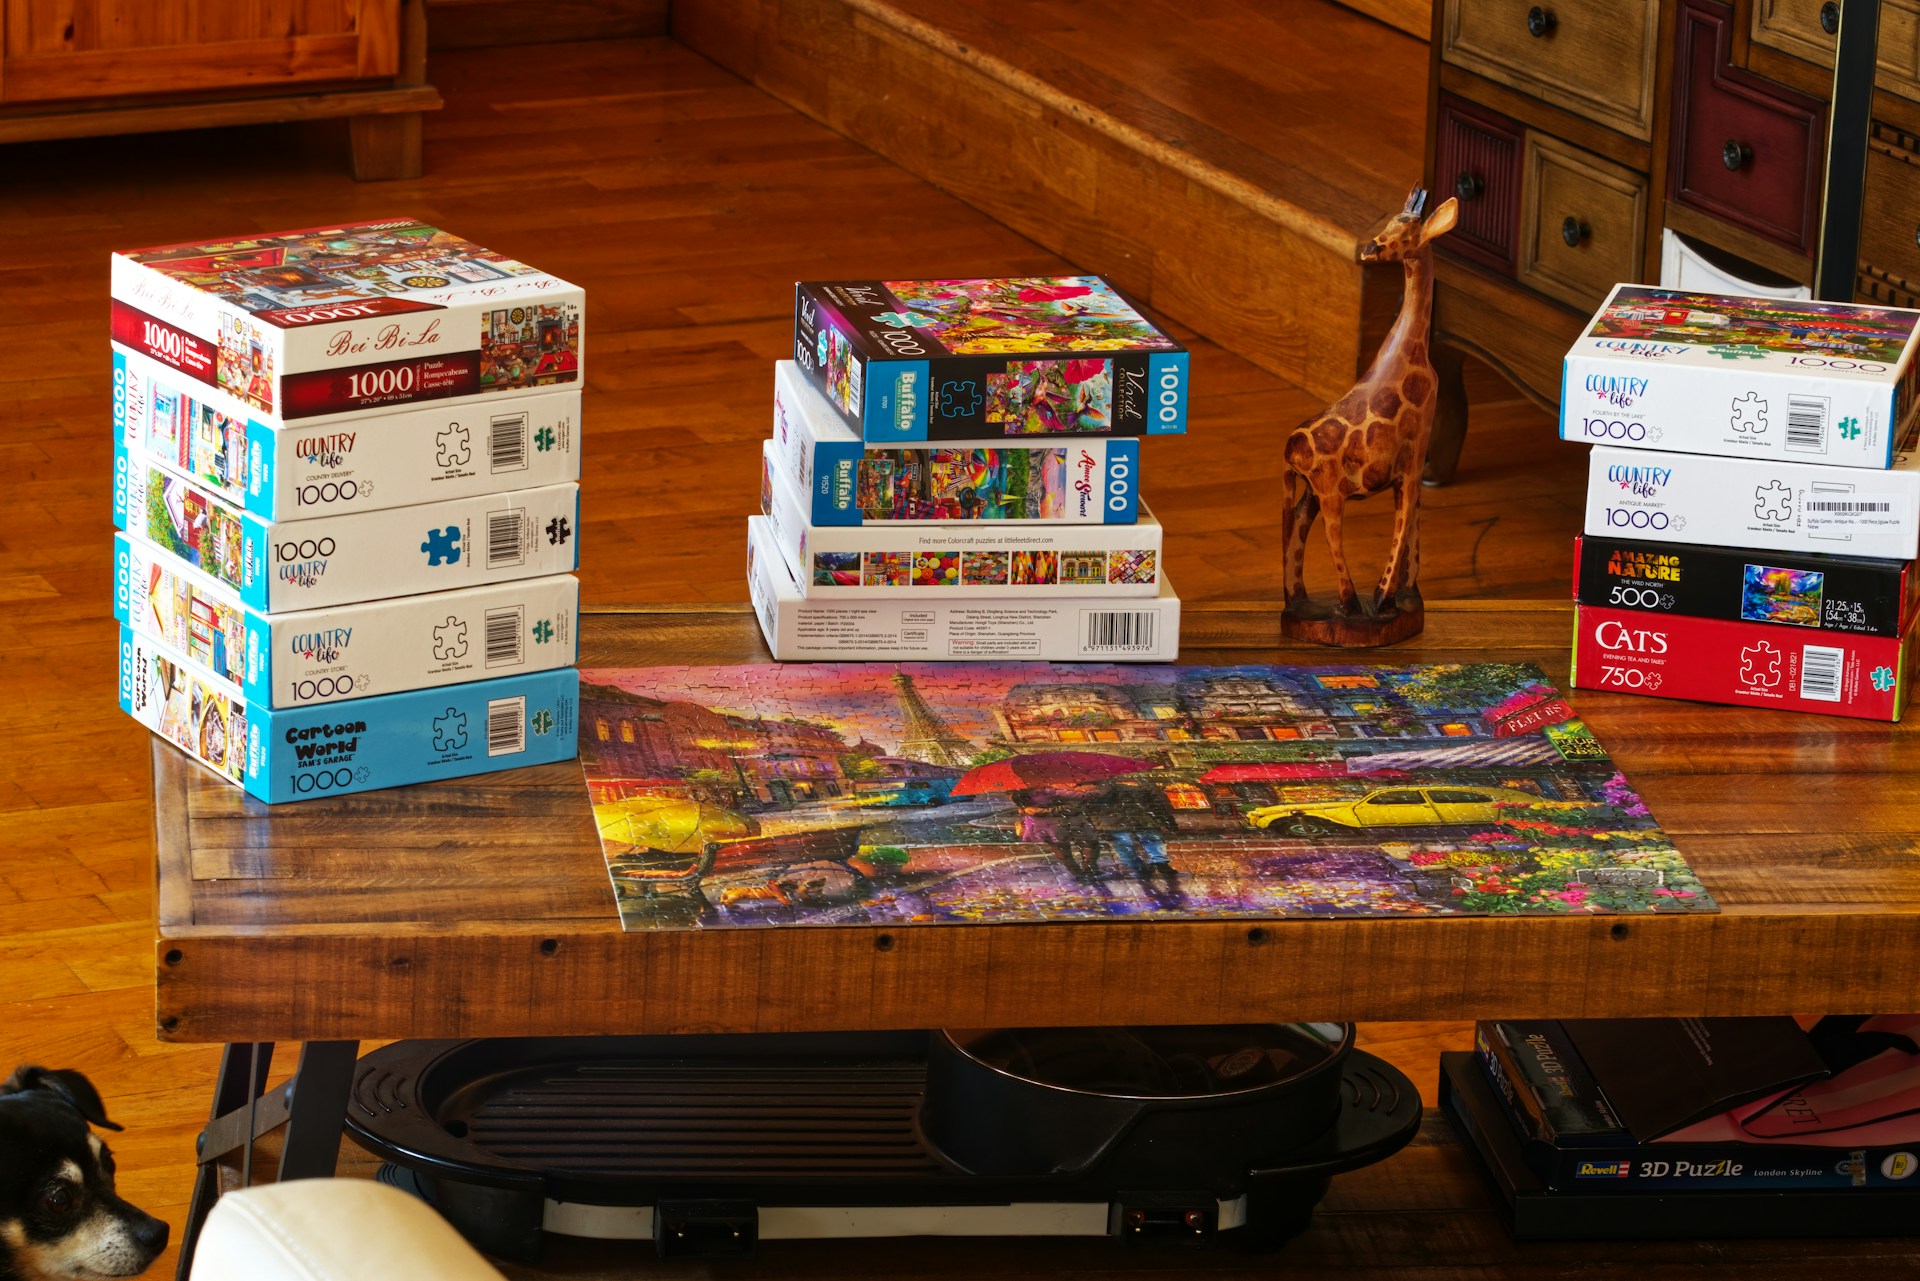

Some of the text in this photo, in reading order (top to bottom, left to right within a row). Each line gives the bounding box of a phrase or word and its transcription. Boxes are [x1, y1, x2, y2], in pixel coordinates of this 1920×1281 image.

[845, 286, 885, 306] Vivid
[285, 306, 380, 323] 1000
[143, 321, 181, 358] 1000
[326, 318, 441, 357] Bei Bi La
[880, 330, 926, 355] 1000
[1595, 340, 1691, 355] COUNTRY
[797, 339, 811, 371] 1000
[1717, 347, 1764, 356] Buffalo
[424, 361, 444, 370] Puzzle
[424, 368, 469, 380] Rompecabezas
[1790, 356, 1887, 373] 1000
[348, 366, 414, 399] 1000
[423, 379, 455, 390] Casse-tête
[1118, 367, 1126, 420] COLLECTION
[1124, 367, 1145, 420] Vivid
[1159, 364, 1179, 422] 1000
[1586, 374, 1649, 398] COUNTRY
[114, 368, 126, 428] 1000
[128, 369, 139, 440] COUNTRY
[901, 371, 917, 431] Buffalo
[1609, 391, 1633, 409] life
[1592, 409, 1613, 417] FOURTH
[1583, 418, 1646, 441] 1000
[296, 432, 357, 459] COUNTRY
[320, 451, 342, 469] life
[116, 456, 128, 515] 1000
[306, 471, 353, 482] COUNTRY DELIVERY
[821, 475, 830, 495] 91520
[840, 459, 852, 510] Buffalo
[1074, 449, 1096, 517] Aimee Stewart
[1109, 454, 1129, 512] 1000
[1608, 464, 1672, 487] COUNTRY
[128, 458, 141, 527] COUNTRY
[296, 480, 358, 506] 1000
[1632, 481, 1656, 499] life
[1605, 508, 1669, 530] 1000
[274, 537, 336, 563] 1000
[919, 537, 931, 545] Find
[948, 537, 974, 545] Colorcraft
[975, 537, 996, 546] puzzles
[1004, 536, 1054, 544] littlefeetdirect.com
[1611, 550, 1680, 567] AMAZING
[118, 551, 129, 612] 1000
[280, 560, 328, 581] COUNTRY
[298, 575, 317, 589] life
[1607, 561, 1681, 582] NATURE
[132, 553, 144, 623] COUNTRY
[1645, 581, 1664, 589] NORTH
[1608, 586, 1660, 609] 500
[292, 627, 353, 655] COUNTRY
[1595, 621, 1668, 654] CATS
[316, 647, 338, 664] life
[1603, 653, 1626, 661] EVENING
[122, 641, 133, 701] 1000
[305, 668, 330, 677] COUNTRY
[1600, 665, 1644, 688] 750
[1789, 651, 1797, 692] DB1-021821
[291, 675, 354, 701] 1000
[1507, 703, 1563, 733] FLEURS
[285, 721, 367, 744] Cartoon
[294, 737, 358, 761] World
[297, 754, 353, 769] SAM'S GARAGE
[290, 768, 353, 794] 1000
[1524, 1033, 1565, 1074] 3D Puzzle
[1580, 1159, 1824, 1178] Revell 3D Puzzle London Skyline
